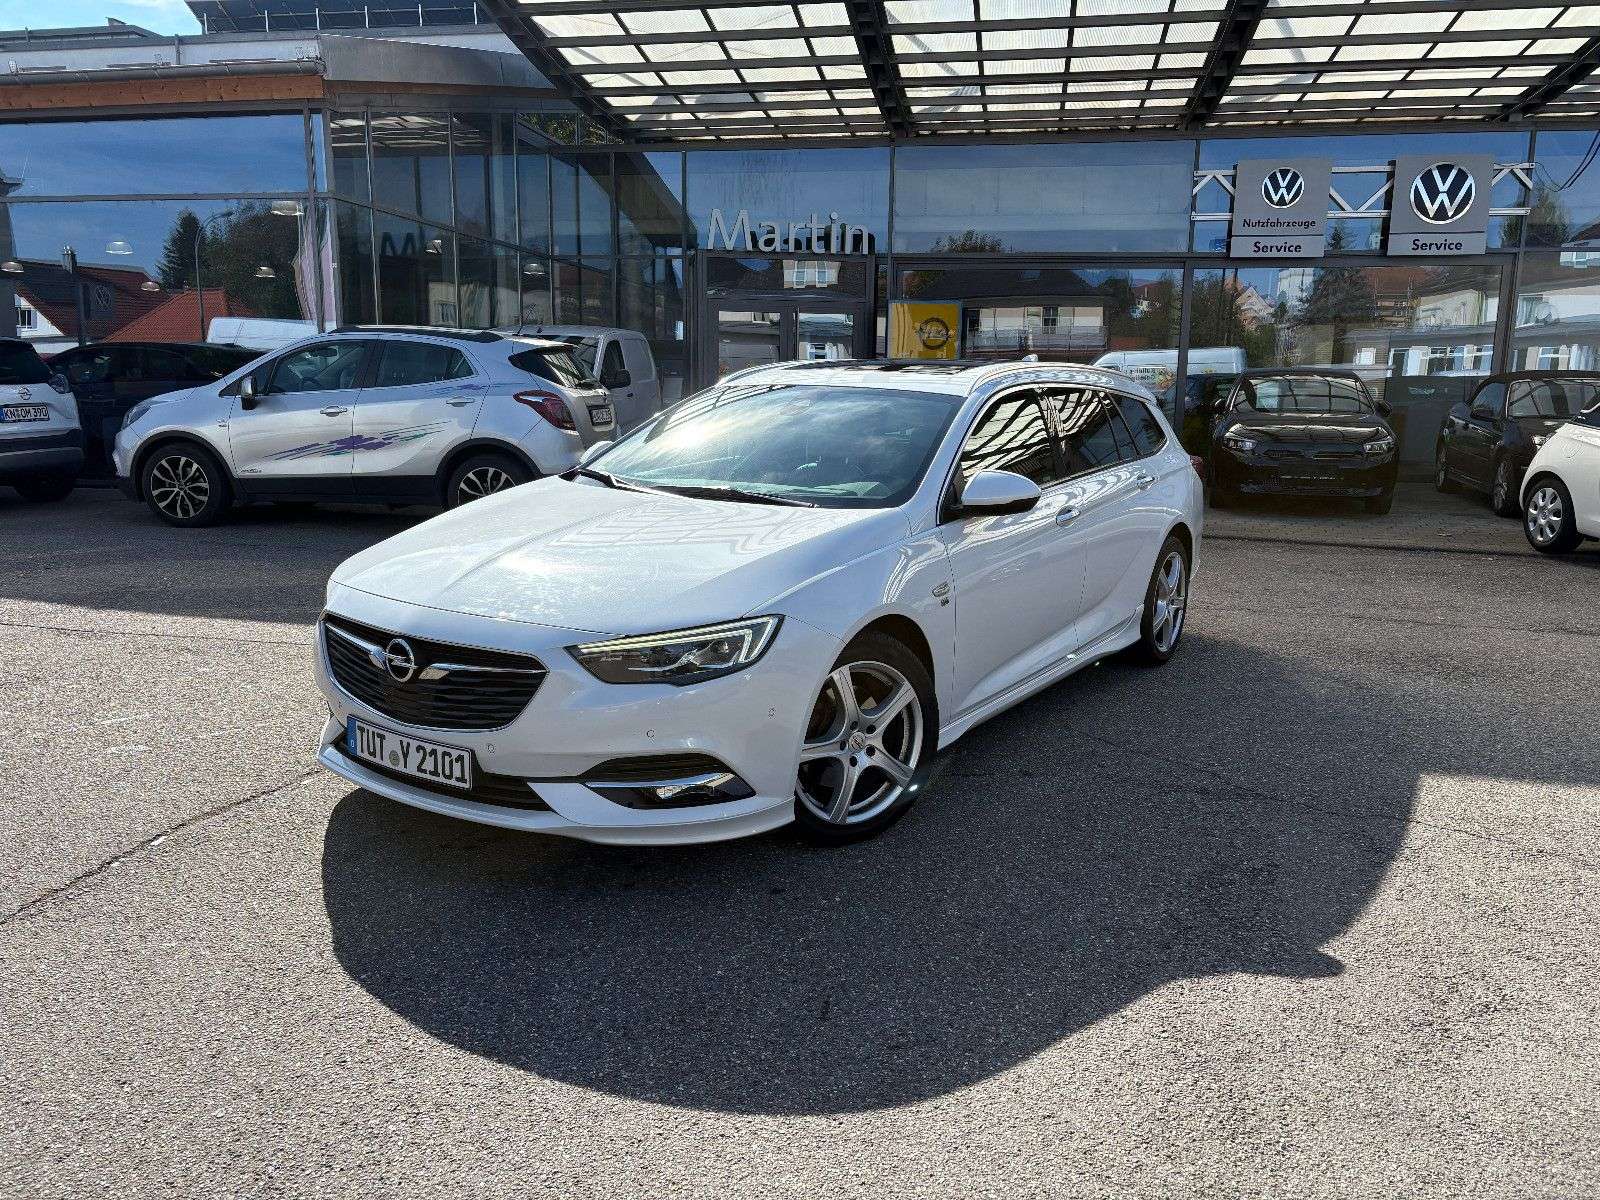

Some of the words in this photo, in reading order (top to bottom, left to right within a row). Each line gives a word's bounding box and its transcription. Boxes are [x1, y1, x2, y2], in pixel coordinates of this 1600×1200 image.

[1242, 218, 1316, 230] Nutzfahrzeuge
[707, 208, 869, 255] Martin
[1252, 241, 1302, 253] Service
[1410, 238, 1463, 251] Service
[356, 725, 386, 761] TUT
[399, 739, 411, 769] Y
[415, 744, 467, 783] 2101
